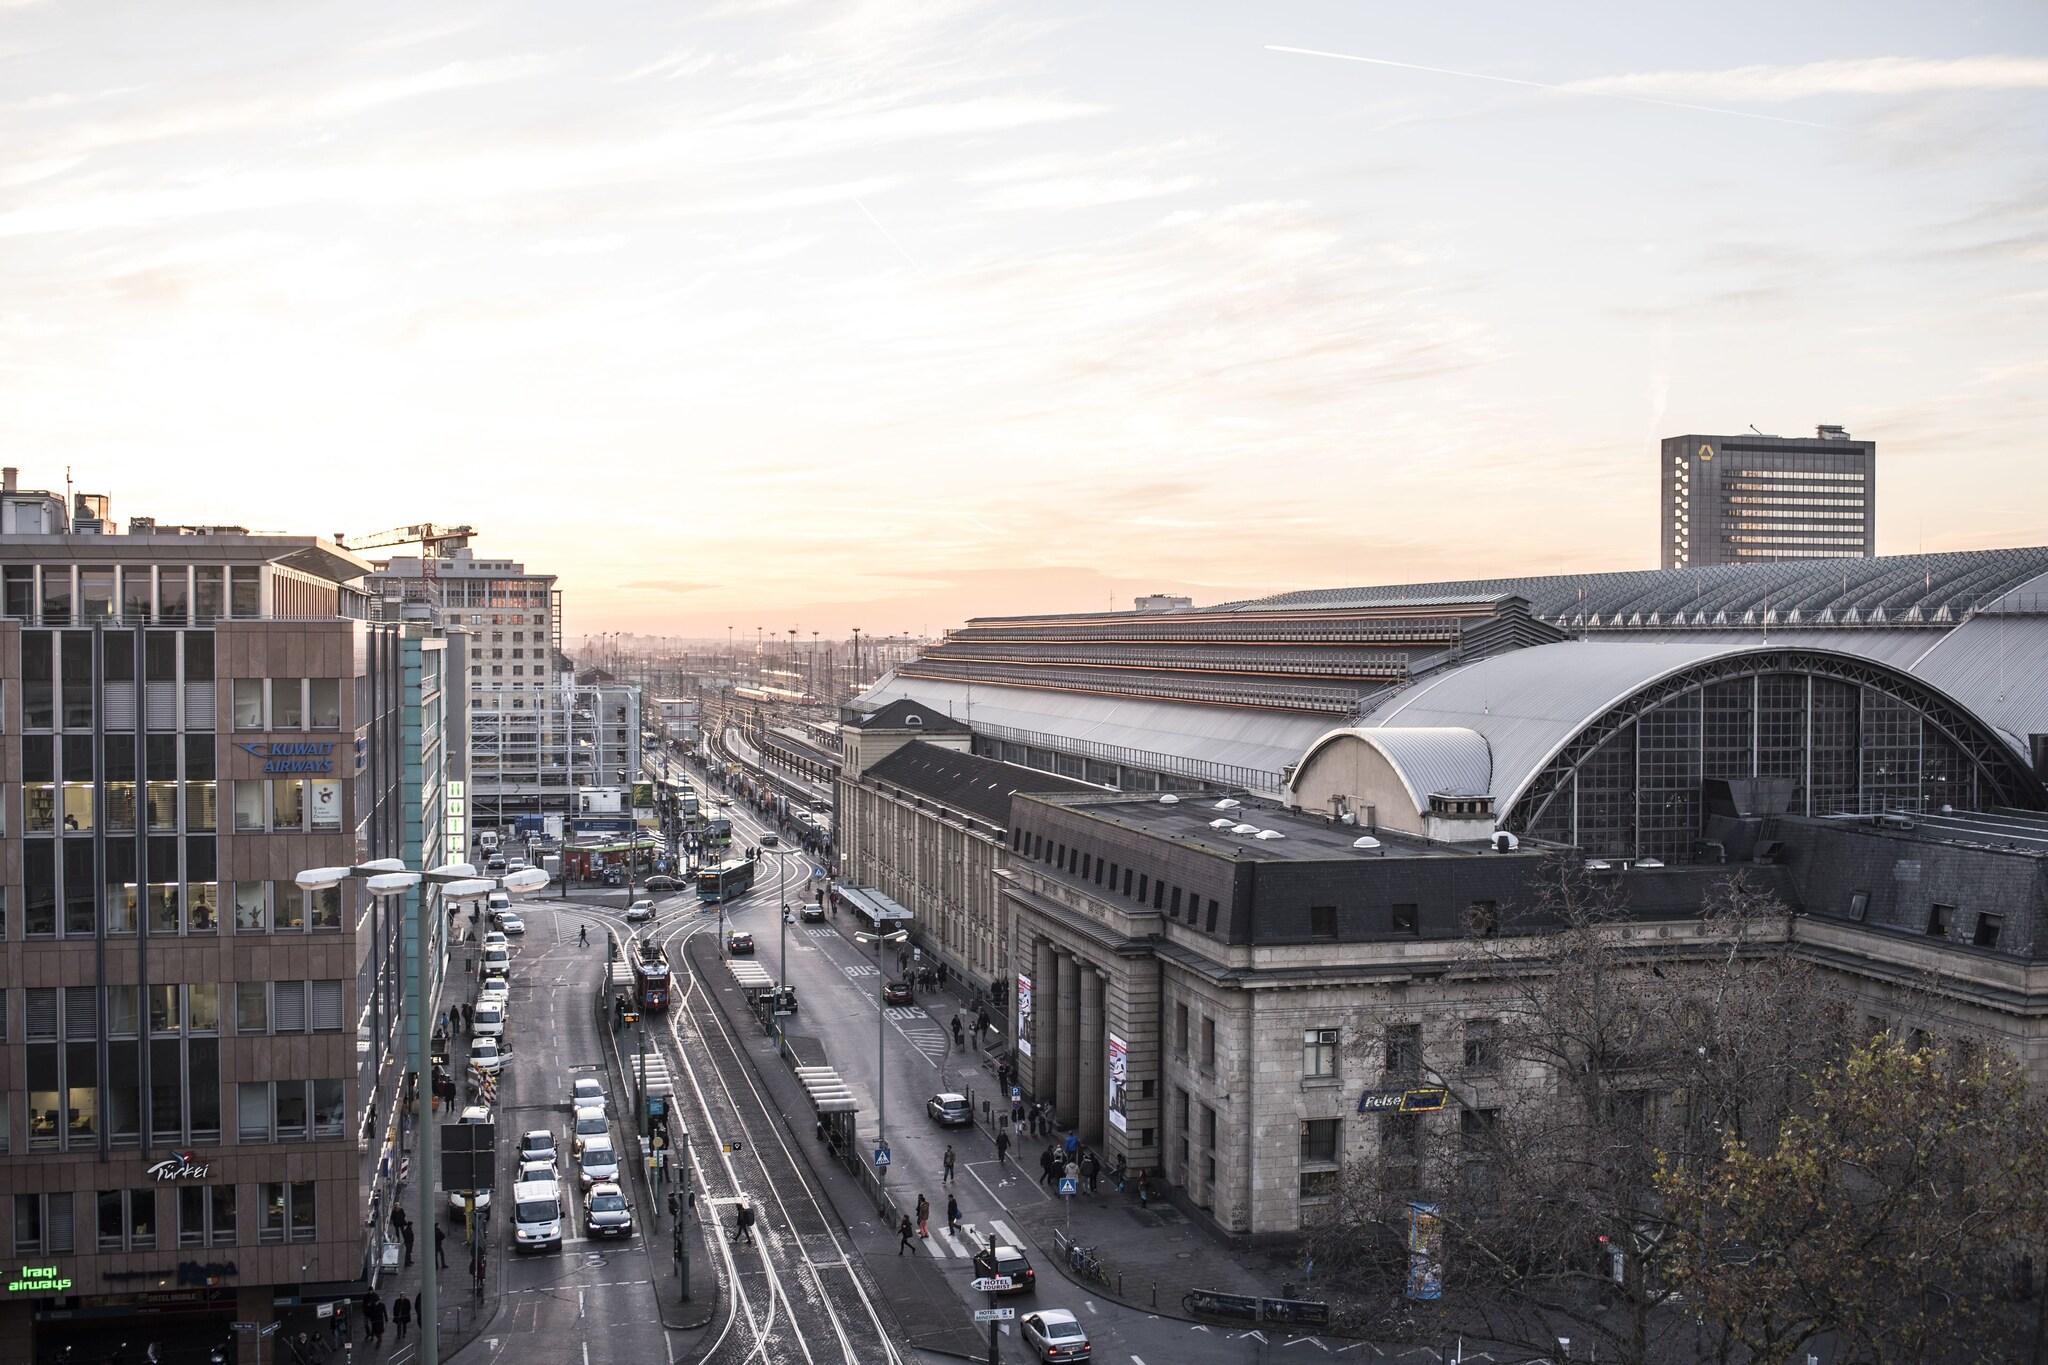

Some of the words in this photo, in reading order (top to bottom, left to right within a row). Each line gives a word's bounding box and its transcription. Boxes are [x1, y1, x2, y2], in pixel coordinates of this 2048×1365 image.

[271, 743, 334, 755] KUWAIT
[263, 760, 333, 773] AIRWAYS
[808, 928, 839, 937] BUS
[844, 965, 880, 977] BUS
[884, 1006, 928, 1021] BUS
[147, 1160, 209, 1182] Türkei
[22, 1266, 57, 1279] Iraqi
[8, 1279, 72, 1291] airways
